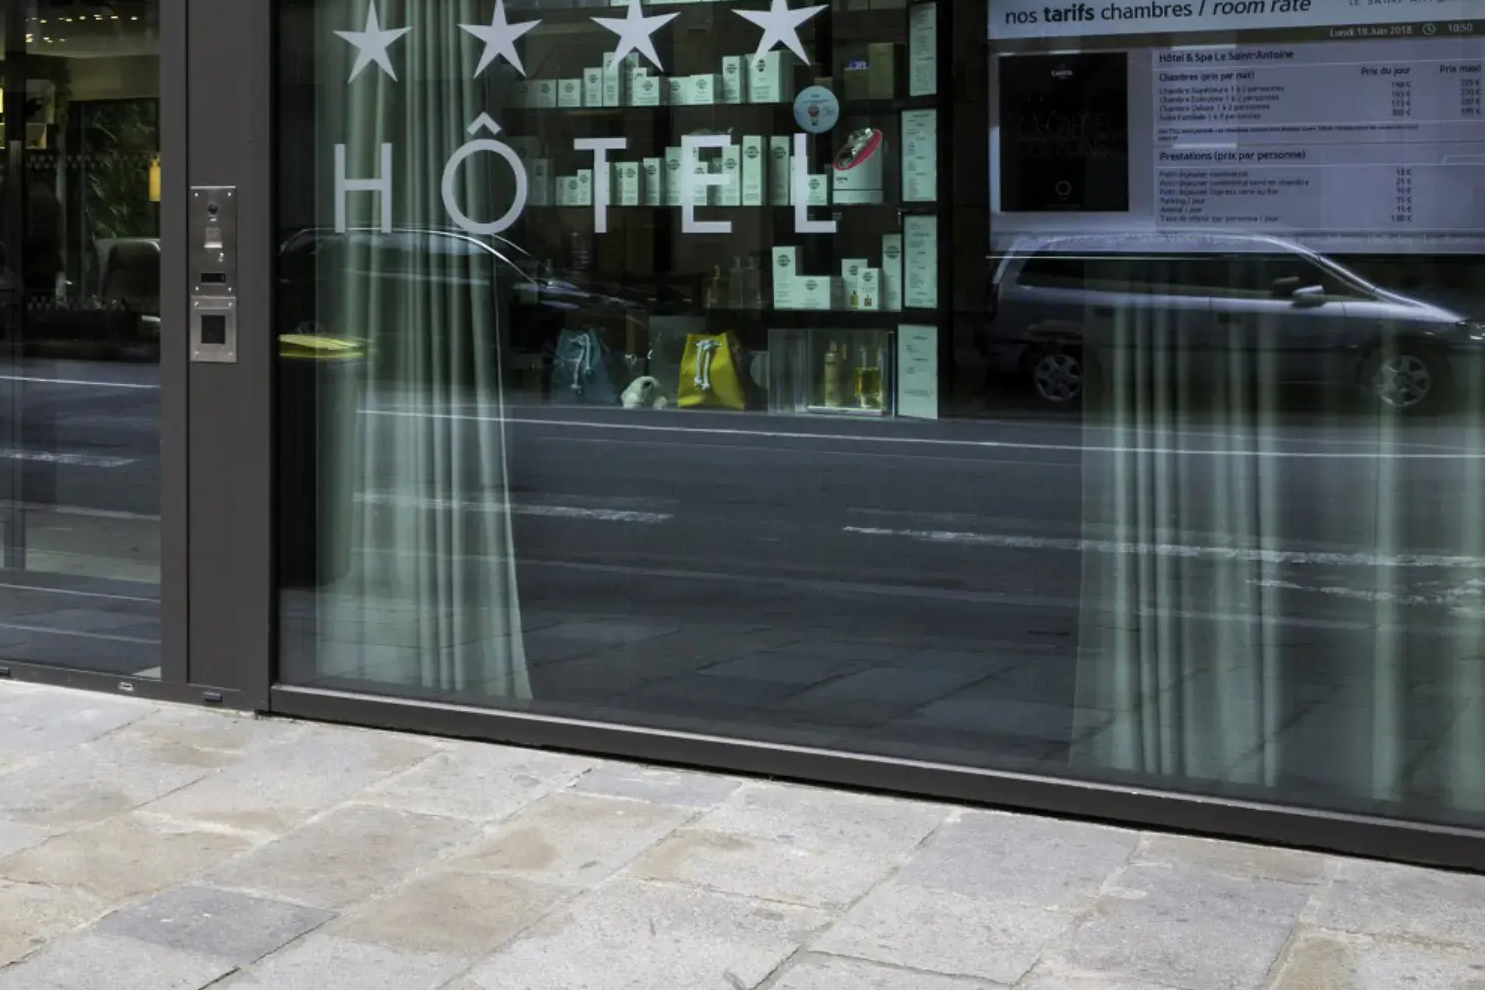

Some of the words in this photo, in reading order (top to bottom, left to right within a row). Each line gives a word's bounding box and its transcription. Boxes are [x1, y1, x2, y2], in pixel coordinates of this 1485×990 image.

[1005, 10, 1038, 24] nos
[1044, 2, 1095, 22] tarifs
[1101, 1, 1192, 20] chambres
[1199, 0, 1206, 16] /
[1159, 52, 1184, 63] Hôtel
[1195, 54, 1213, 64] Spa
[1215, 52, 1225, 61] Le
[1159, 73, 1198, 82] Chambres
[1159, 151, 1212, 161] Prestations
[1214, 150, 1237, 161] (prix
[1239, 152, 1254, 161] par
[1257, 150, 1306, 161] personne)
[333, 111, 837, 233] HÔTEL
